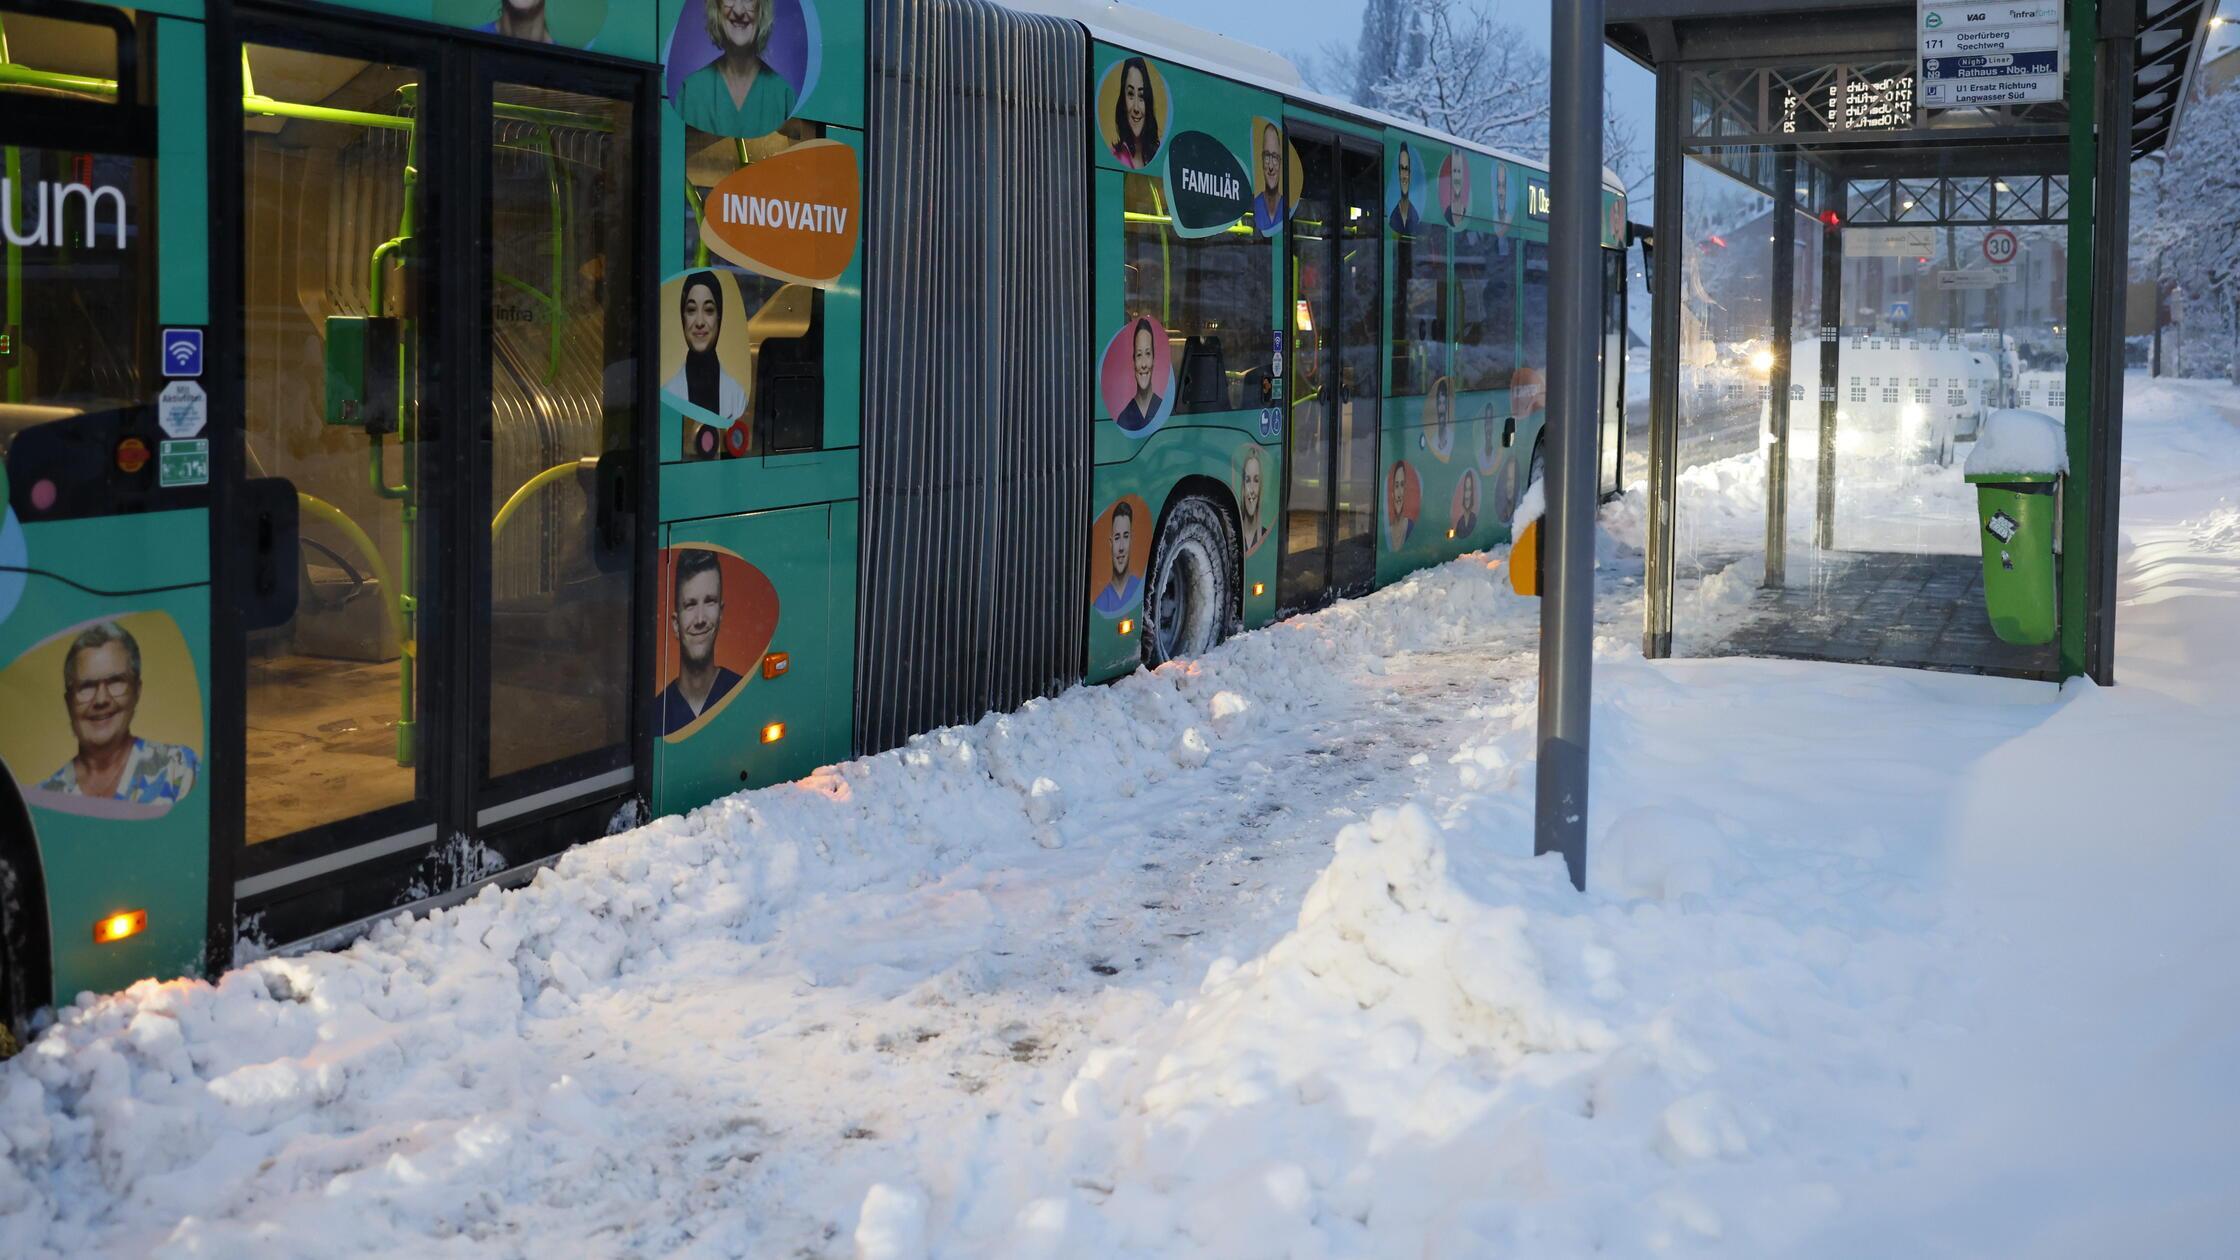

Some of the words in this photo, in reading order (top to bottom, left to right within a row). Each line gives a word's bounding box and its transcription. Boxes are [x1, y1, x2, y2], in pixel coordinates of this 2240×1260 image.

[1966, 13, 1986, 21] VAG
[1956, 31, 2010, 41] Oberfürberg
[1925, 40, 1943, 49] 171
[1956, 41, 2005, 51] Spechtweg
[1988, 56, 2010, 64] Liner
[1927, 70, 1941, 79] N9
[1957, 67, 1998, 77] Rathaus
[2031, 64, 2052, 73] Hbf.
[1956, 84, 1968, 92] U1
[1970, 82, 1997, 92] Ersatz
[1999, 81, 2037, 91] Richtung
[1956, 93, 2005, 103] Langwasser
[2007, 91, 2025, 100] Süd
[1182, 168, 1240, 201] FAMILIÄR
[2, 178, 126, 249] um
[723, 193, 847, 234] INNOVATIV
[1989, 238, 2010, 255] 30
